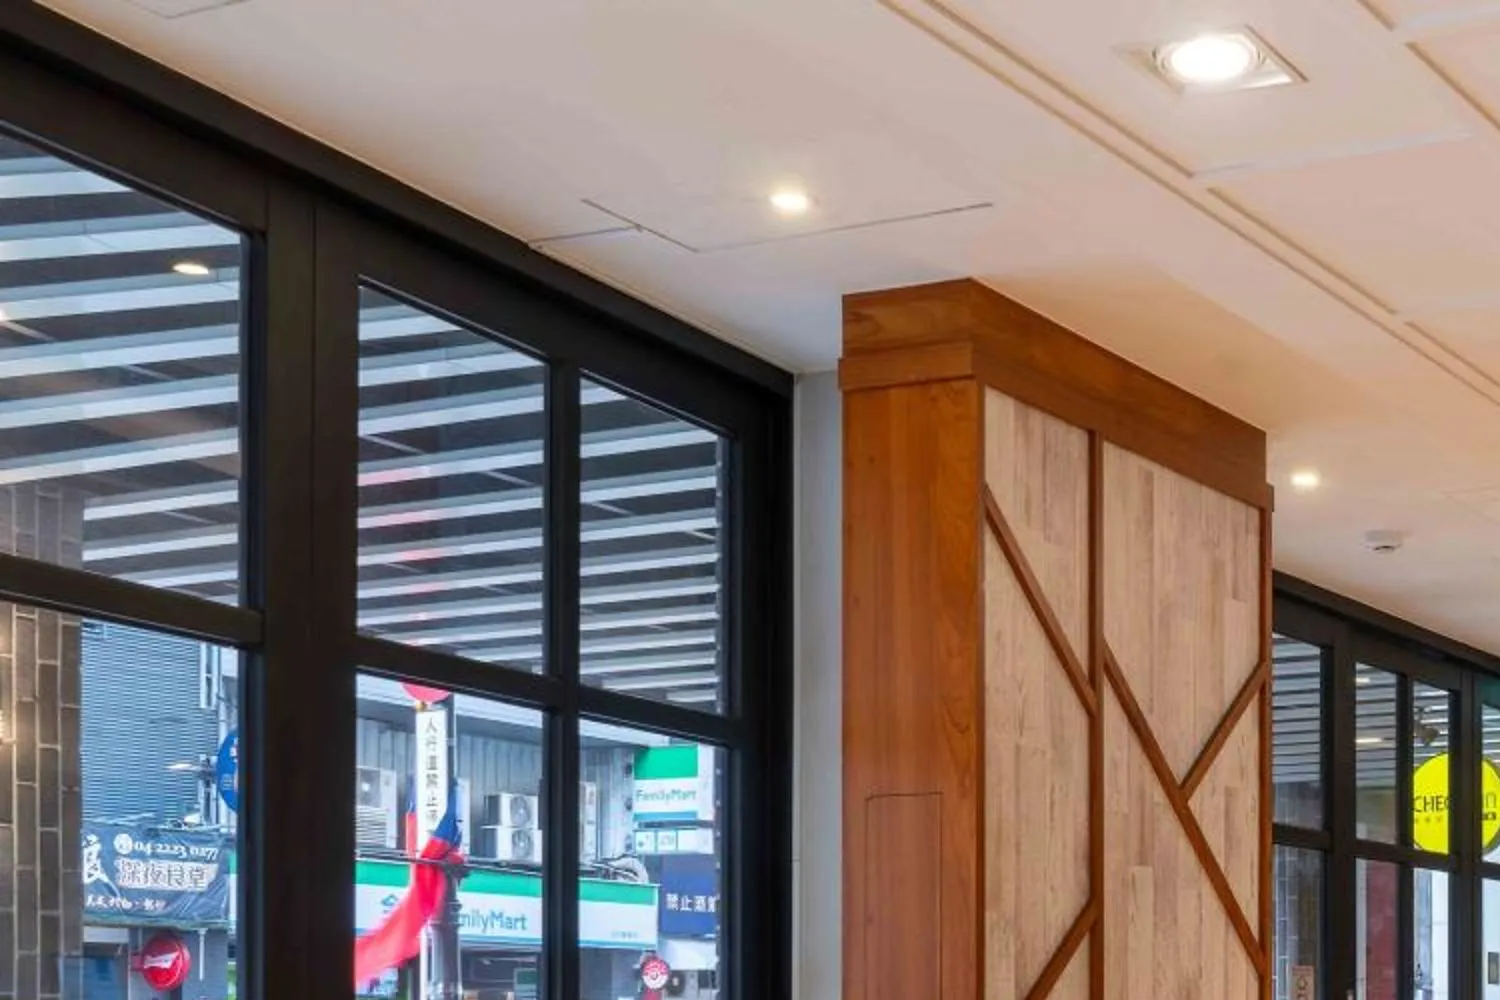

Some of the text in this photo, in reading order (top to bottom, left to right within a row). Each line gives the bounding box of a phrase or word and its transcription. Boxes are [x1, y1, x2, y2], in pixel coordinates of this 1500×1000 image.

[635, 788, 698, 805] FamilyMart
[120, 858, 207, 889] 深夜食堂
[459, 911, 528, 934] milyMart
